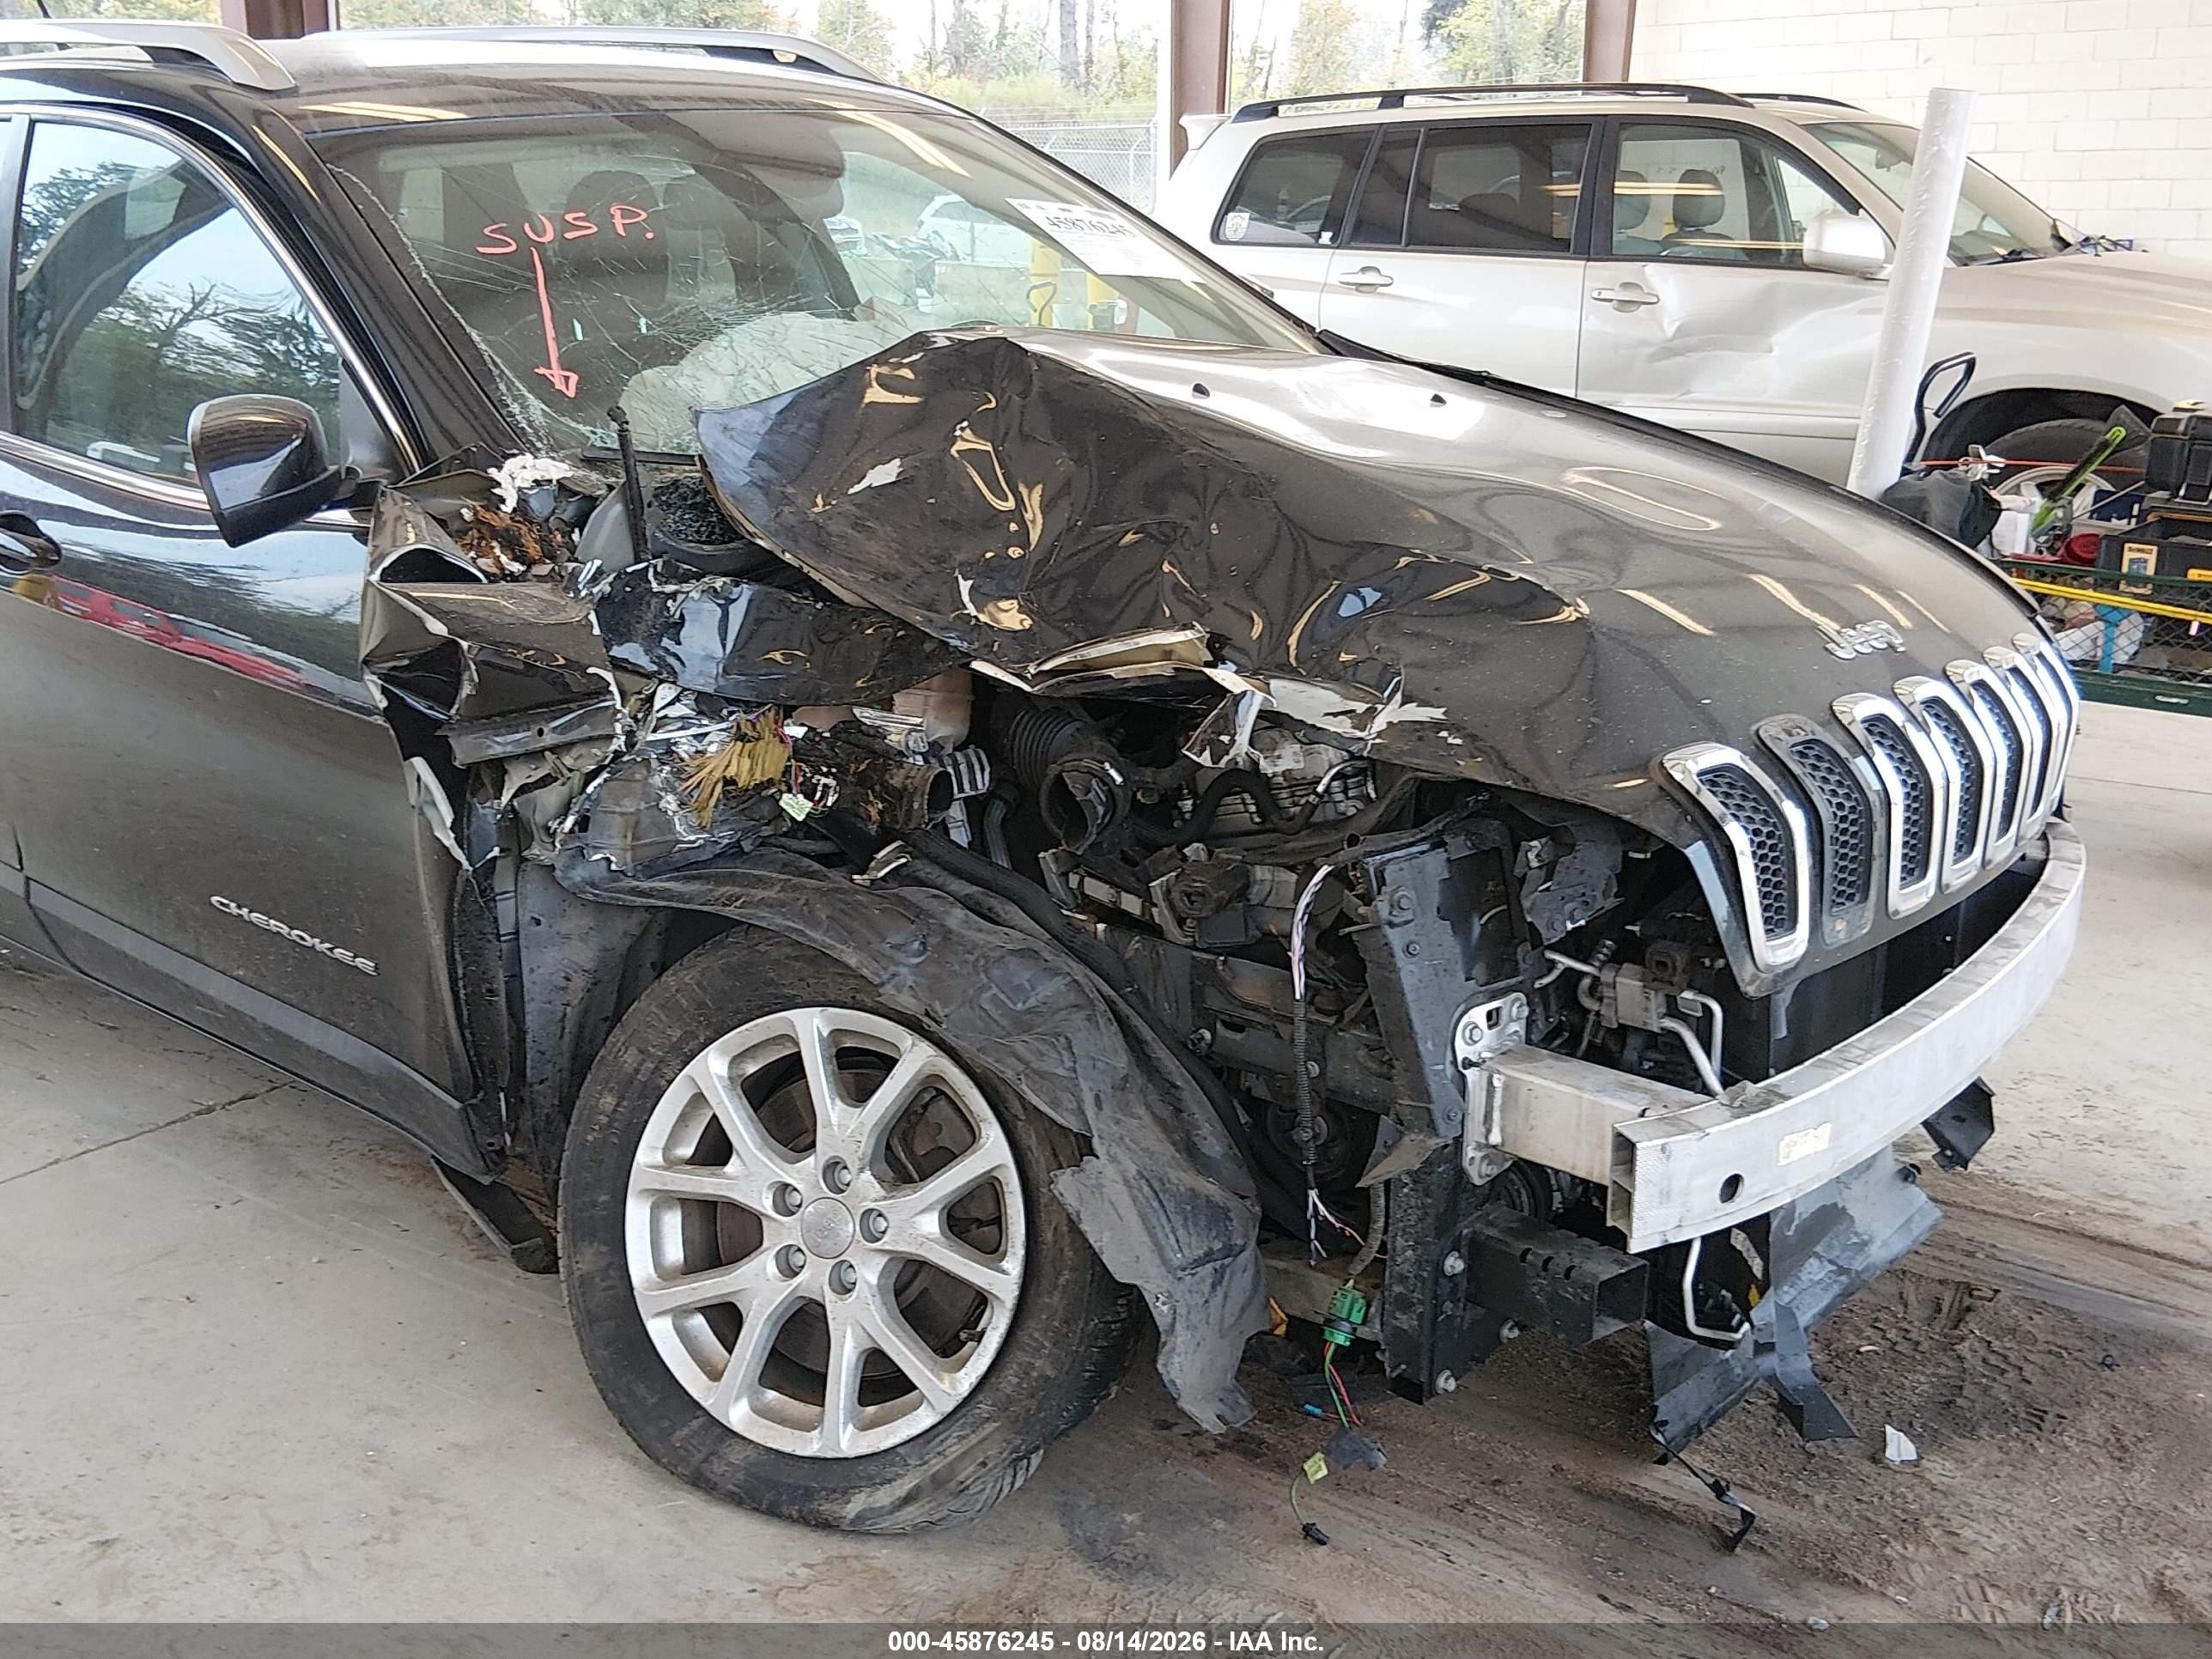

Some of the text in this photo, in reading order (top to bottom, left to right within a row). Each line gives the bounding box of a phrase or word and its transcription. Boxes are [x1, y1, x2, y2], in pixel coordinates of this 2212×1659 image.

[476, 203, 654, 254] SUSP.
[1045, 215, 1137, 238] 45876245
[210, 896, 379, 976] CHEROKEE
